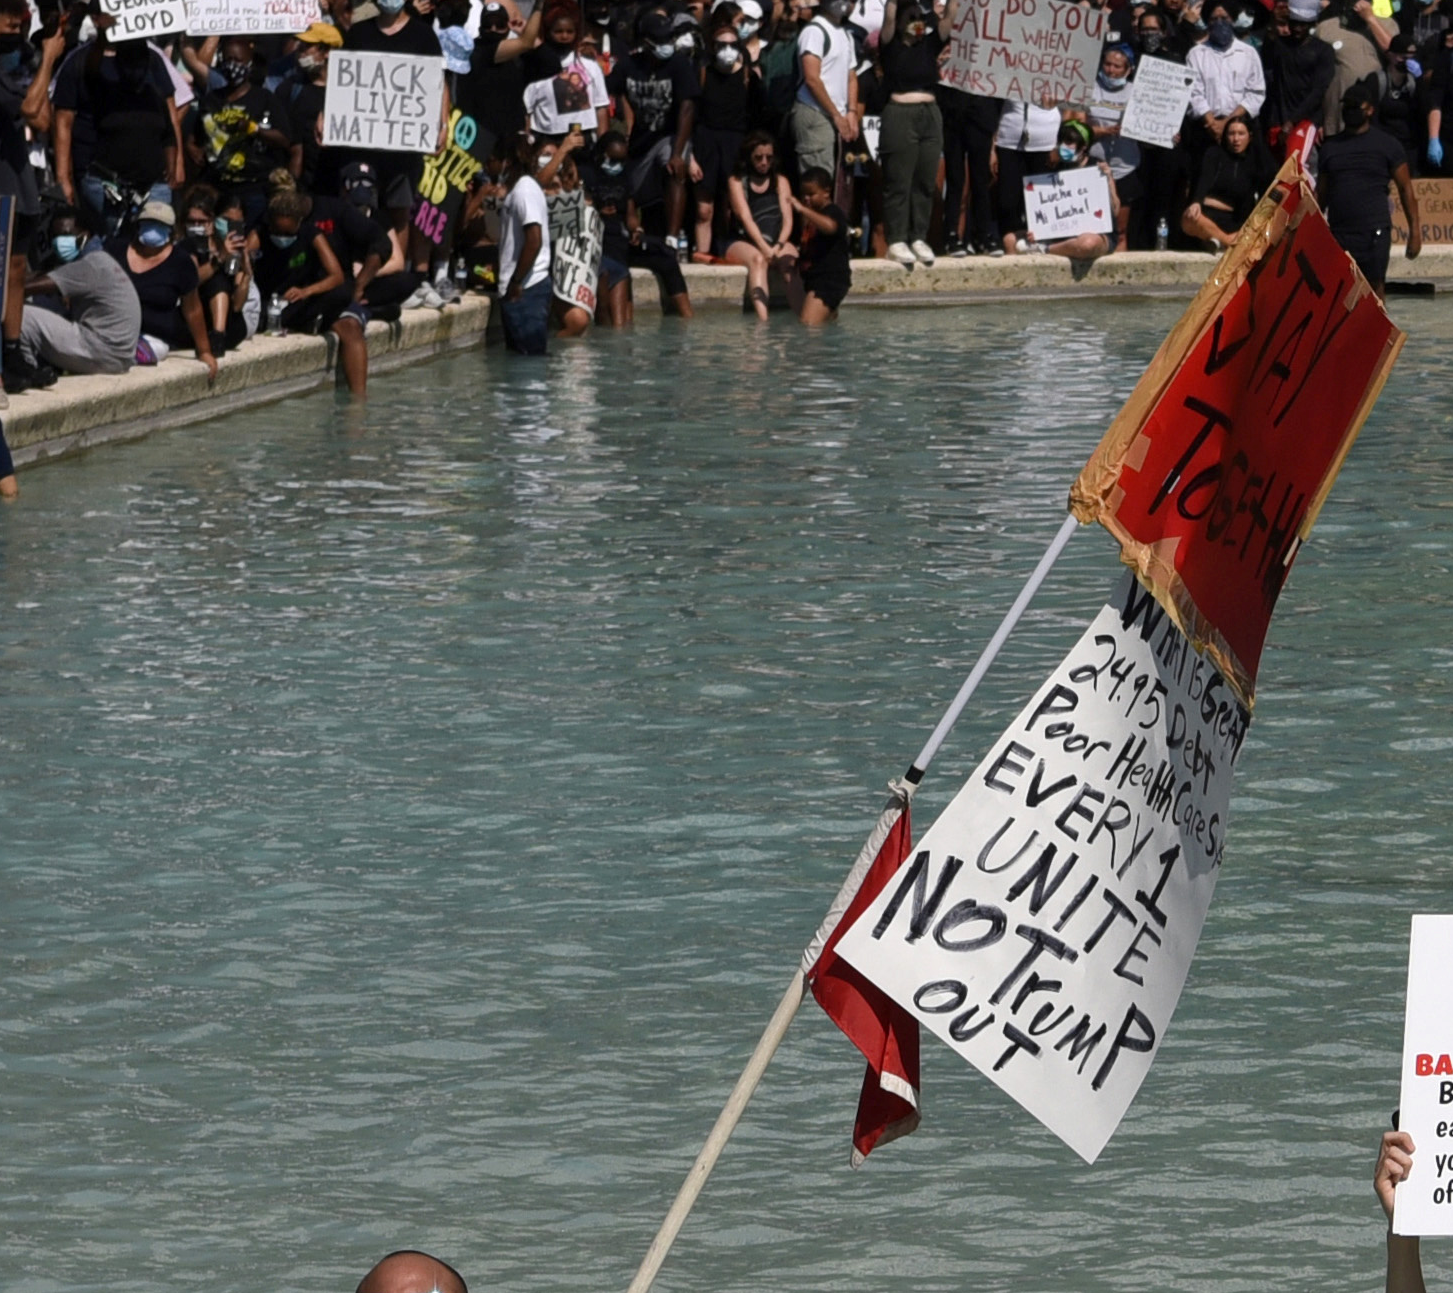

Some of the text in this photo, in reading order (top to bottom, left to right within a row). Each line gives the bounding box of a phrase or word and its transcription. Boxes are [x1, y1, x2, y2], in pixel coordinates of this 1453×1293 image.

[107, 10, 174, 36] FLOYD
[1048, 1, 1103, 41] YOU
[1021, 27, 1072, 54] WHEN
[337, 58, 427, 96] BLACK
[988, 46, 1087, 82] MURDERER
[353, 91, 427, 120] LIVES
[1007, 77, 1024, 99] A
[329, 113, 432, 149] MATTER
[1024, 683, 1112, 759] Poor
[983, 739, 1183, 930] EVERY 1
[976, 816, 1163, 987] UNITE
[911, 978, 1043, 1072] OUT
